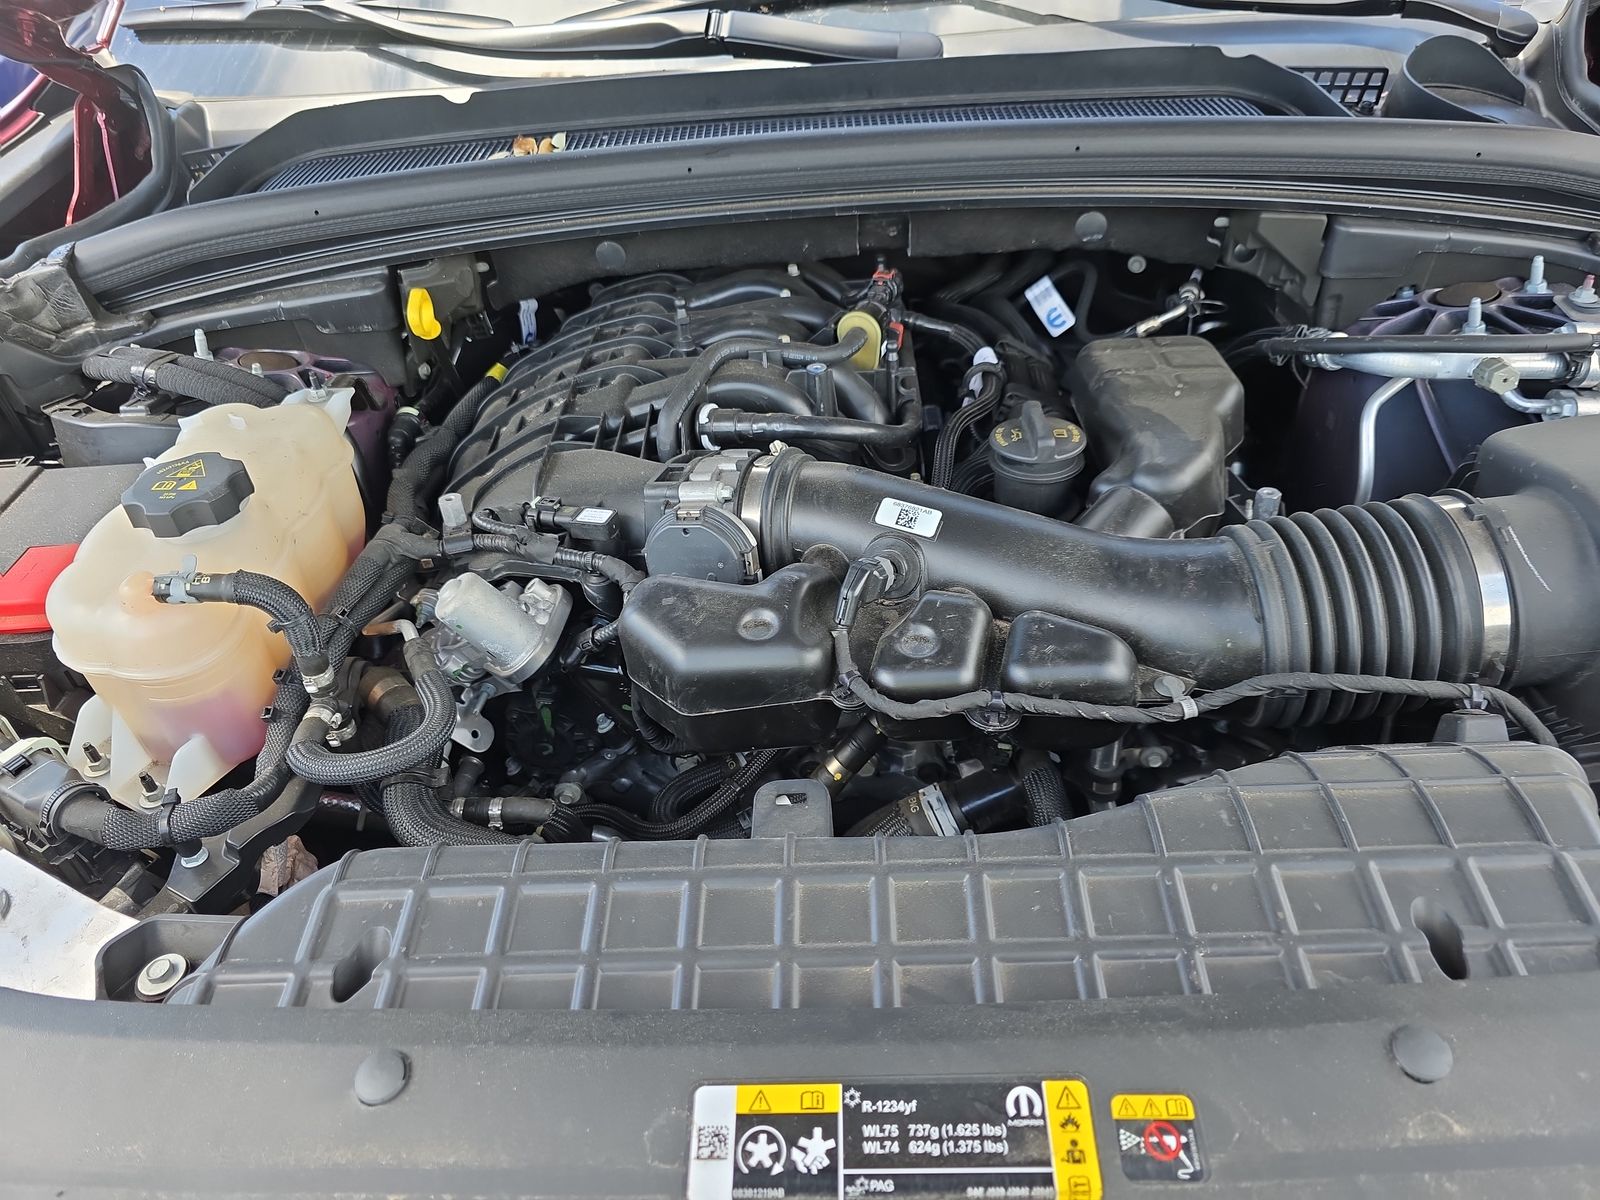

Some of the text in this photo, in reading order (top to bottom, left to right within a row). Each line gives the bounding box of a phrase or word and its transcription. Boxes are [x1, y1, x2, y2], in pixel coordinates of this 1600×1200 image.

[861, 1099, 918, 1116] R-1234yf
[862, 1122, 1008, 1140] WL75 737g (1.625 lbs)
[862, 1139, 1010, 1156] WL74 624g (1.375 lbs)
[869, 1179, 895, 1193] PAG
